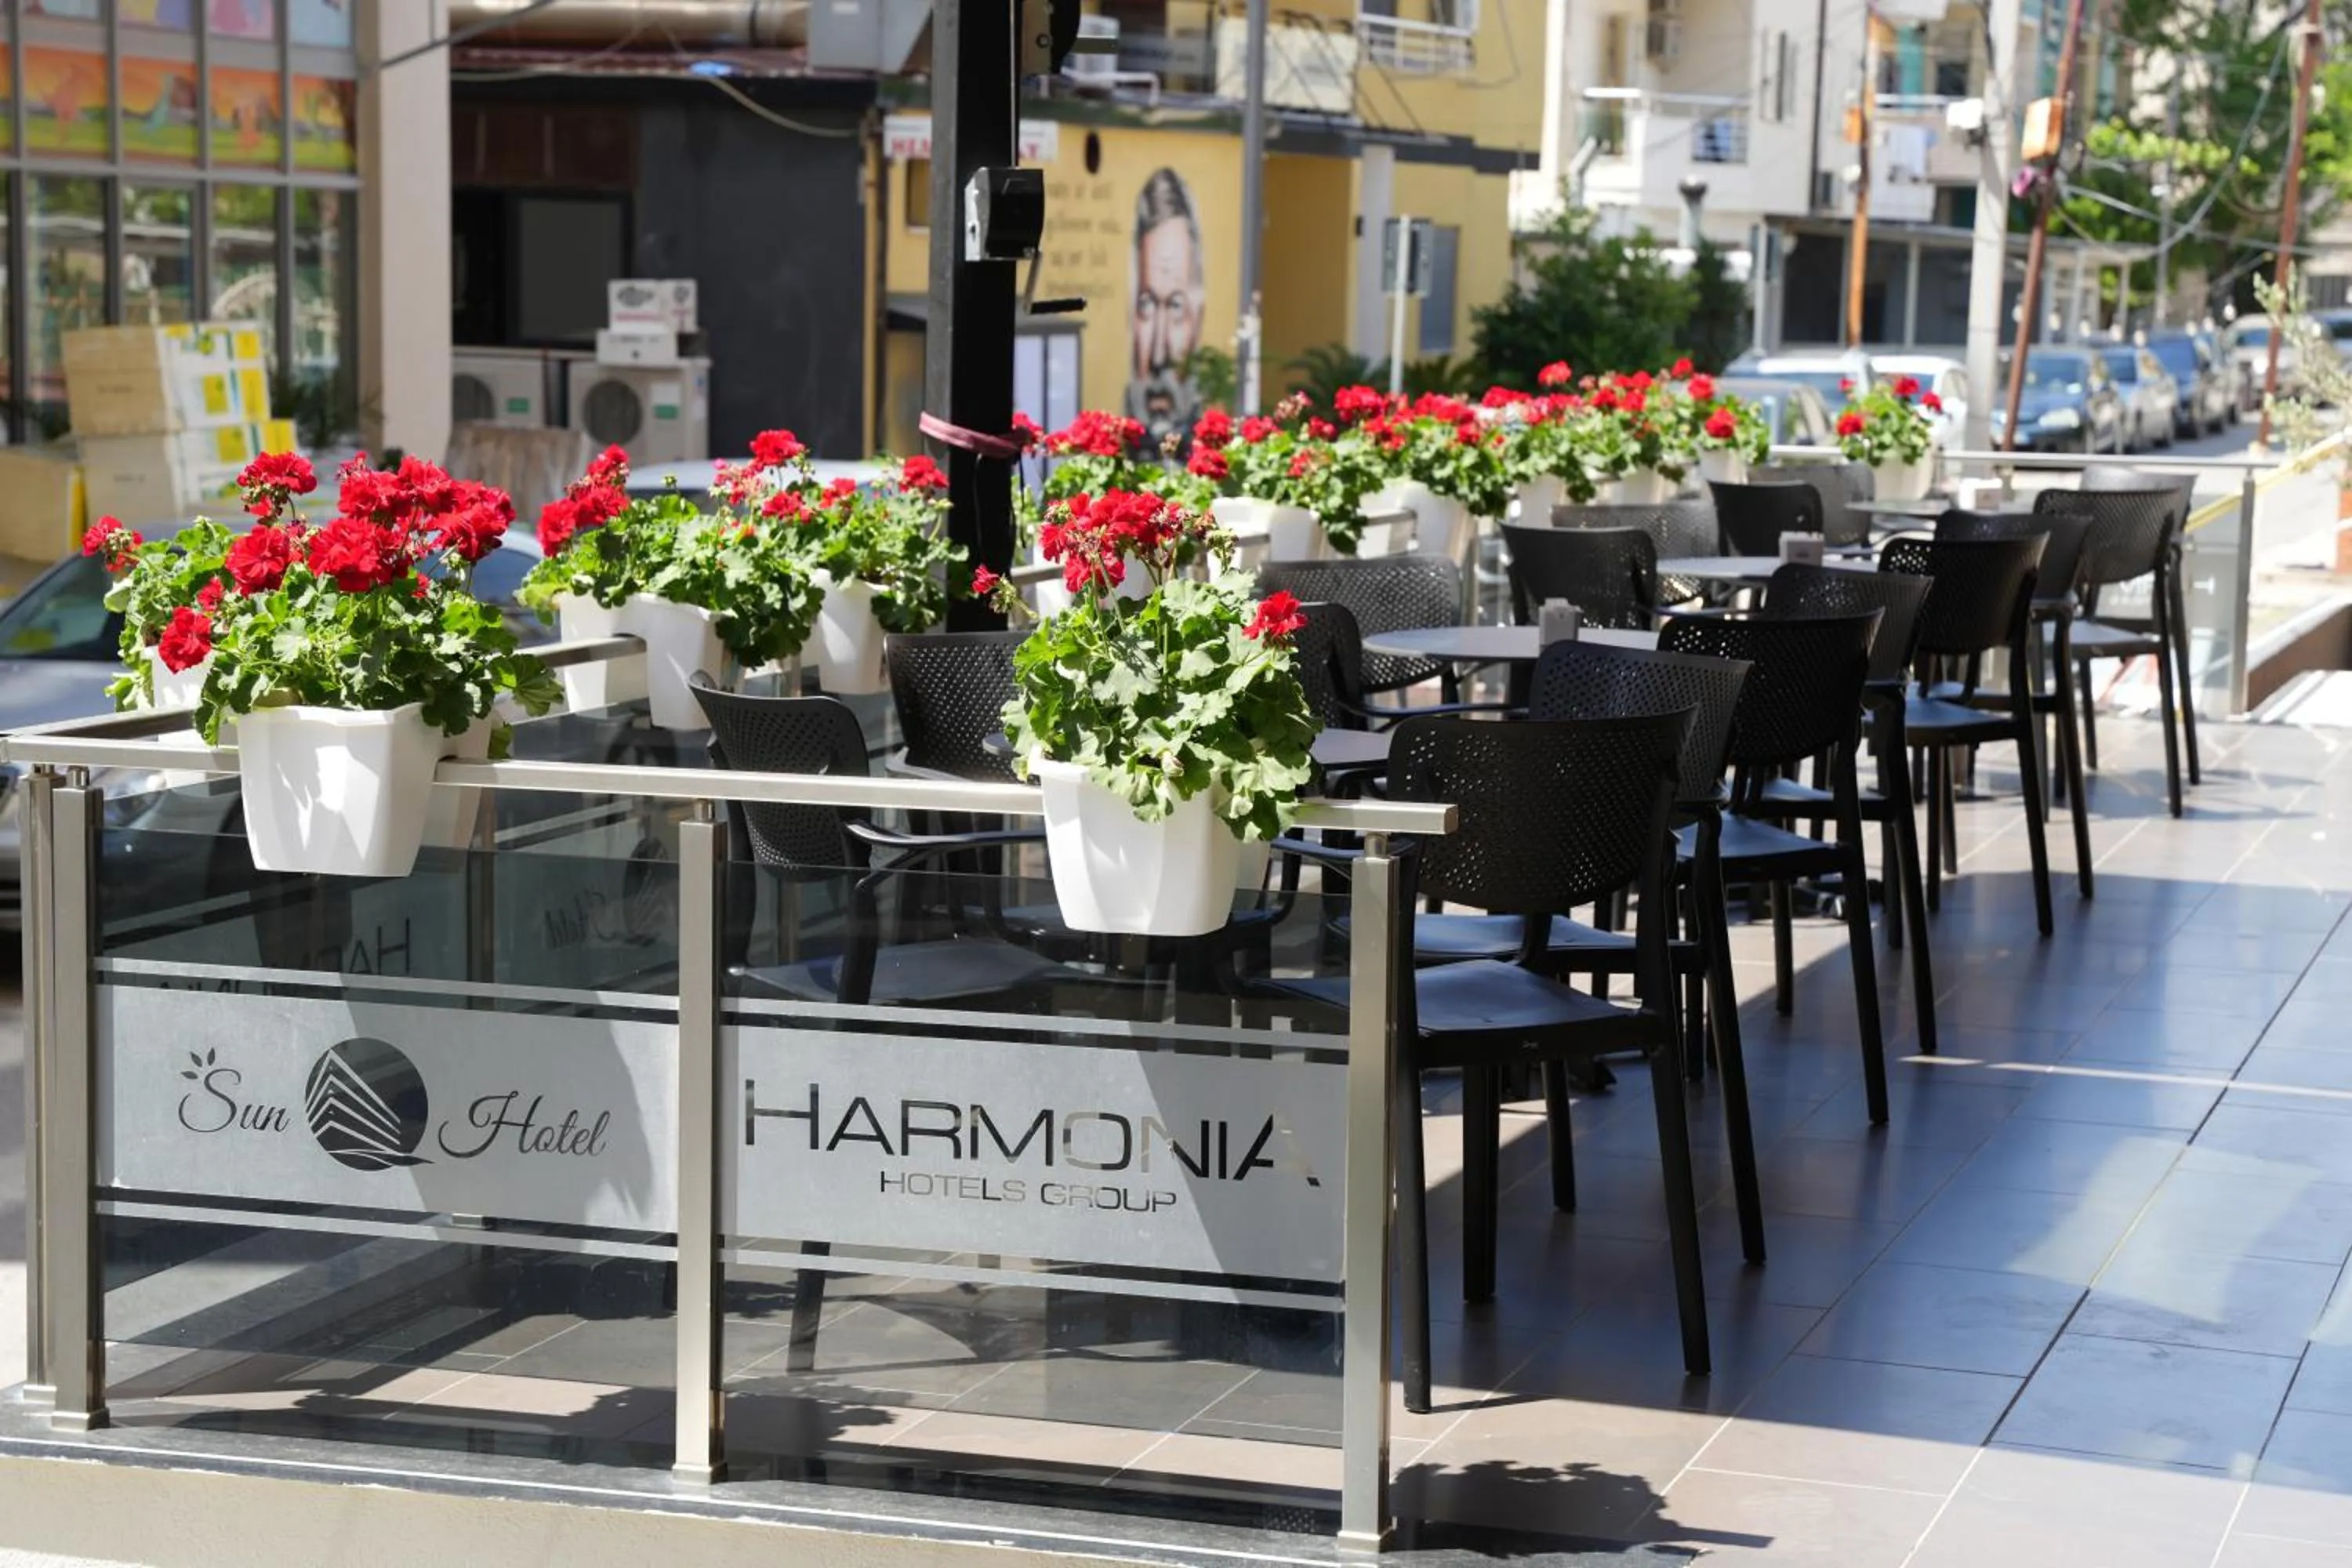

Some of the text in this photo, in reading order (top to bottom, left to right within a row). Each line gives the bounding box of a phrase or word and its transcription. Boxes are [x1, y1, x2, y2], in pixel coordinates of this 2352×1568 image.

[178, 1067, 611, 1159] Sun Hotel
[745, 1078, 1321, 1188] HARMONIA
[880, 1170, 1177, 1213] HOTELS GROUP
